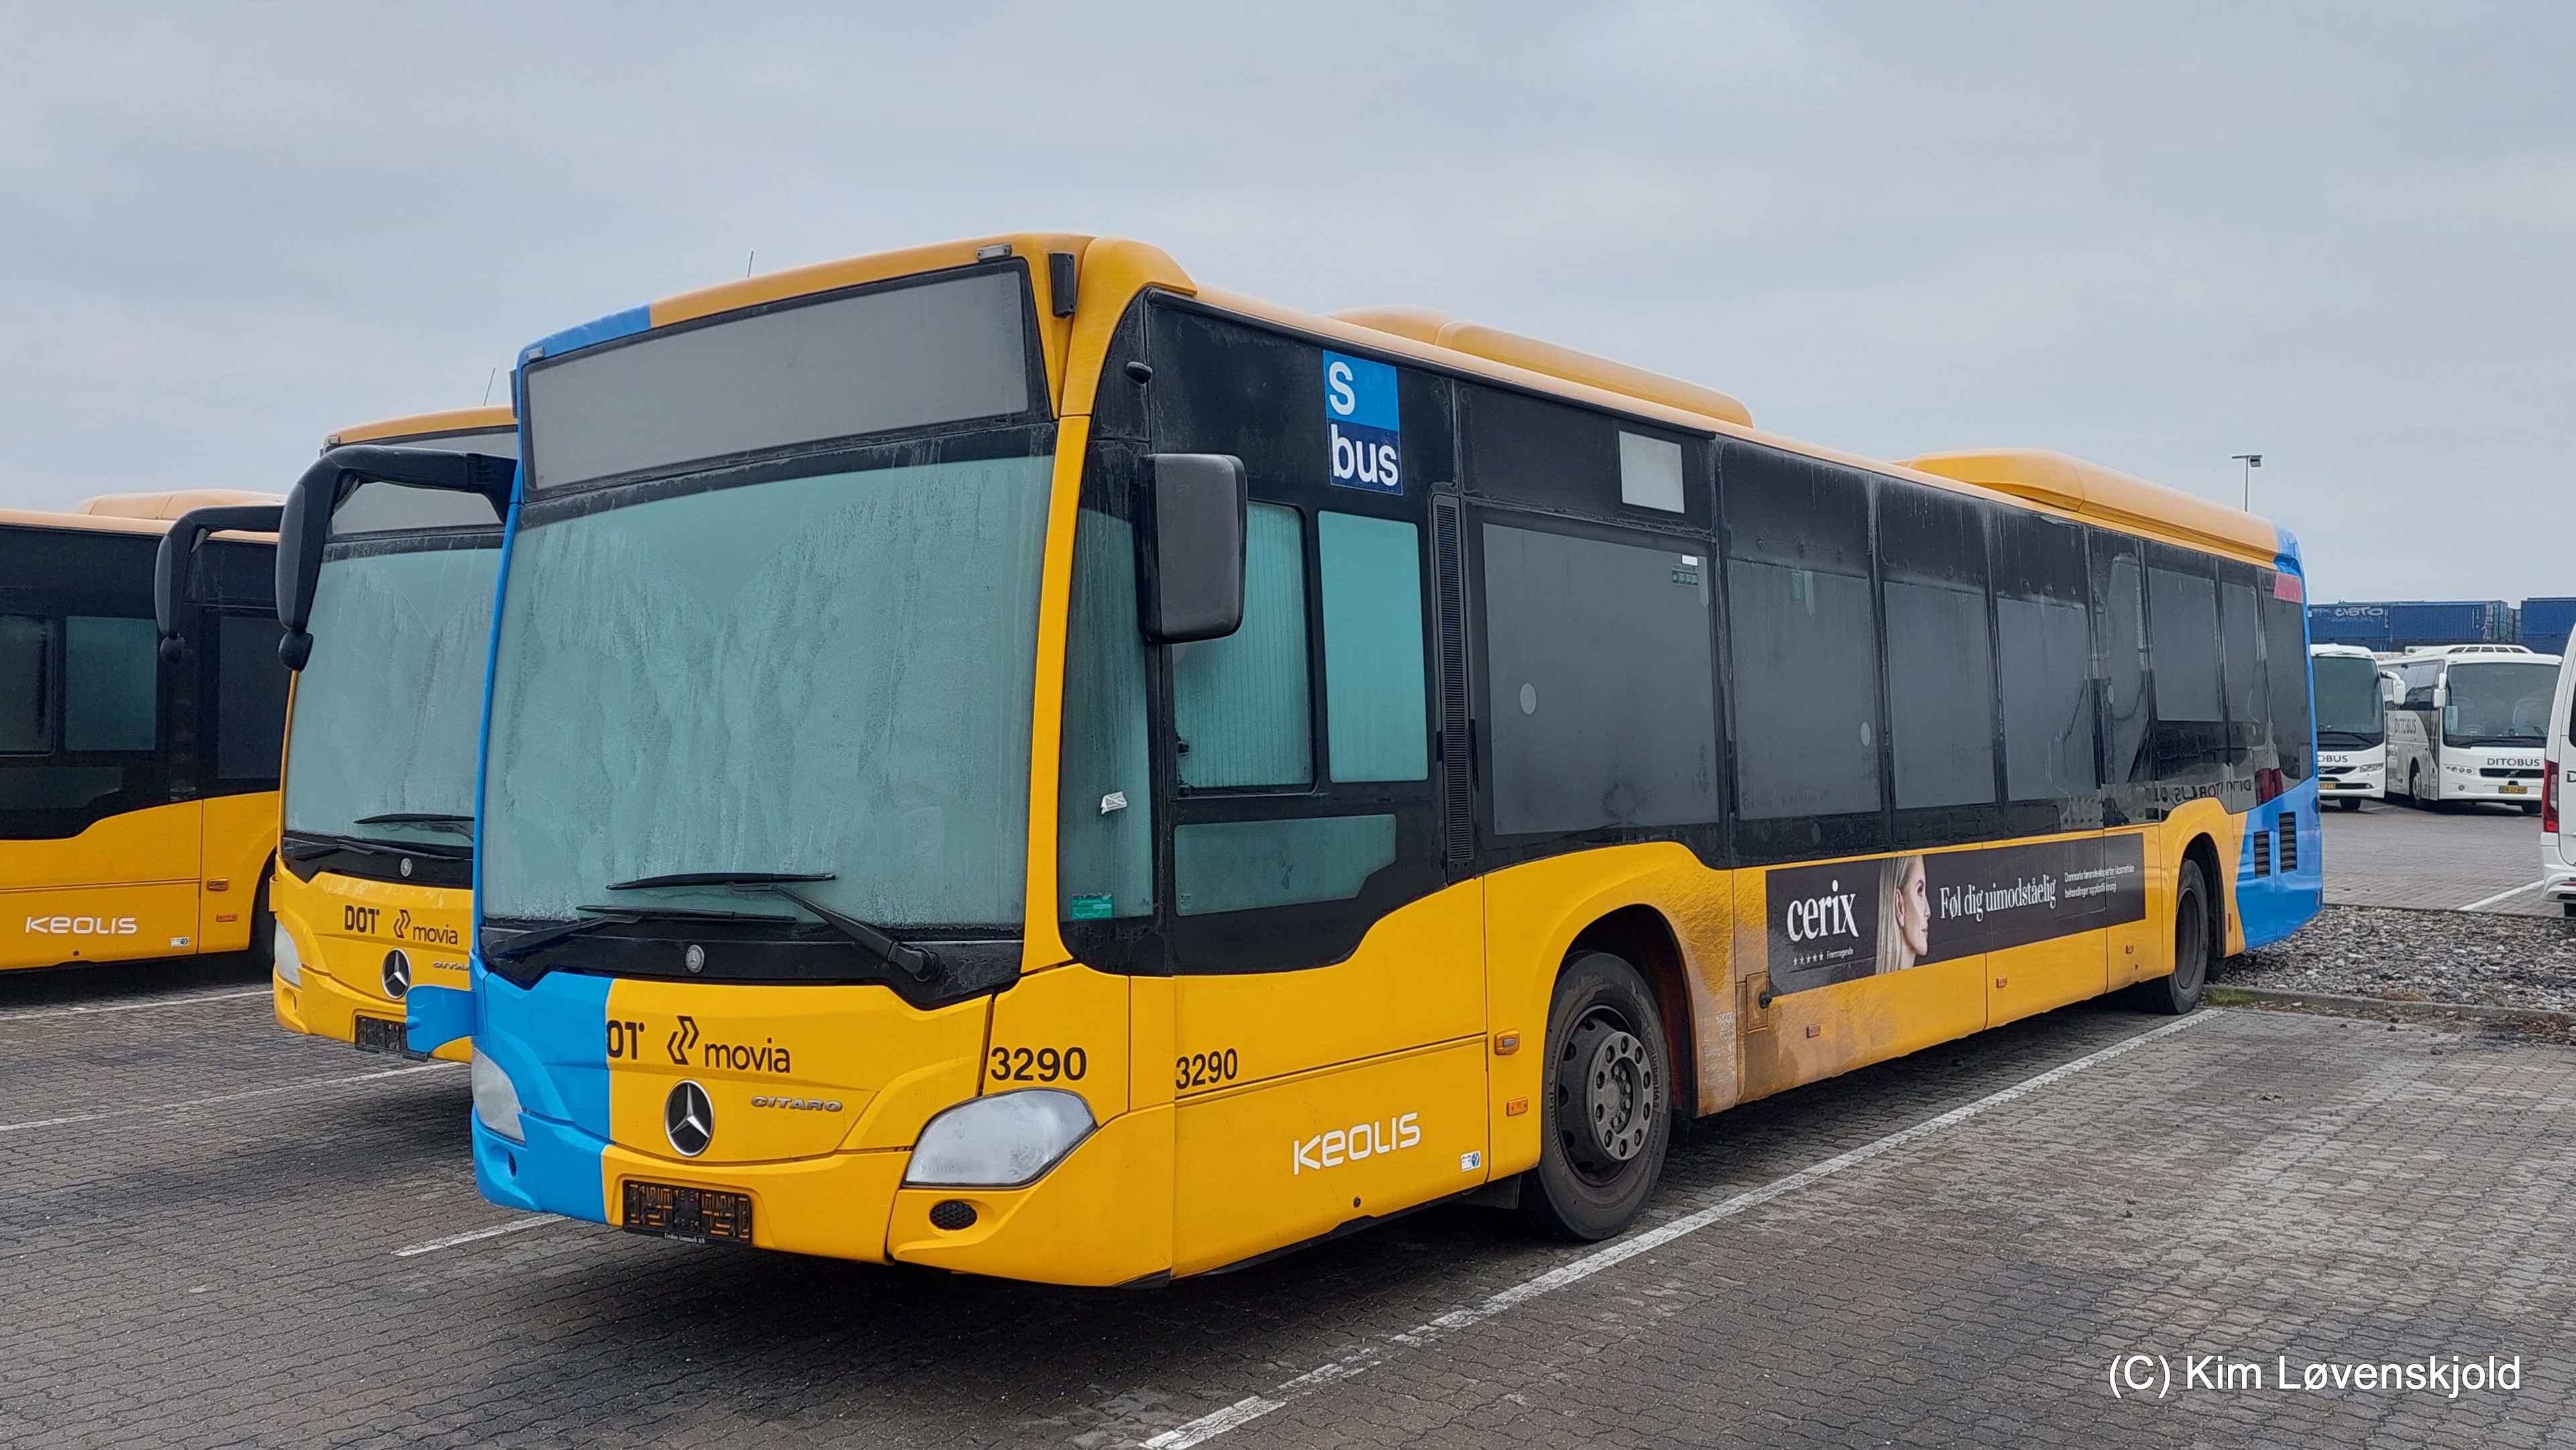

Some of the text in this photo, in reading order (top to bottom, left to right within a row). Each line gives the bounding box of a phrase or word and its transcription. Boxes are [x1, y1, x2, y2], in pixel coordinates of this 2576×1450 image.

[1328, 360, 1356, 416] S
[1331, 424, 1399, 486] bus
[2318, 755, 2349, 763] OBUS
[2487, 758, 2540, 767] DITOBUS
[1787, 879, 1859, 942] cerix
[1940, 874, 2057, 922] Føl dig uimodståelig
[413, 923, 458, 946] movia
[704, 1037, 791, 1073] movia
[990, 1046, 1087, 1082] 3290
[1175, 1048, 1238, 1090] 3290
[751, 1096, 843, 1112] CITARO
